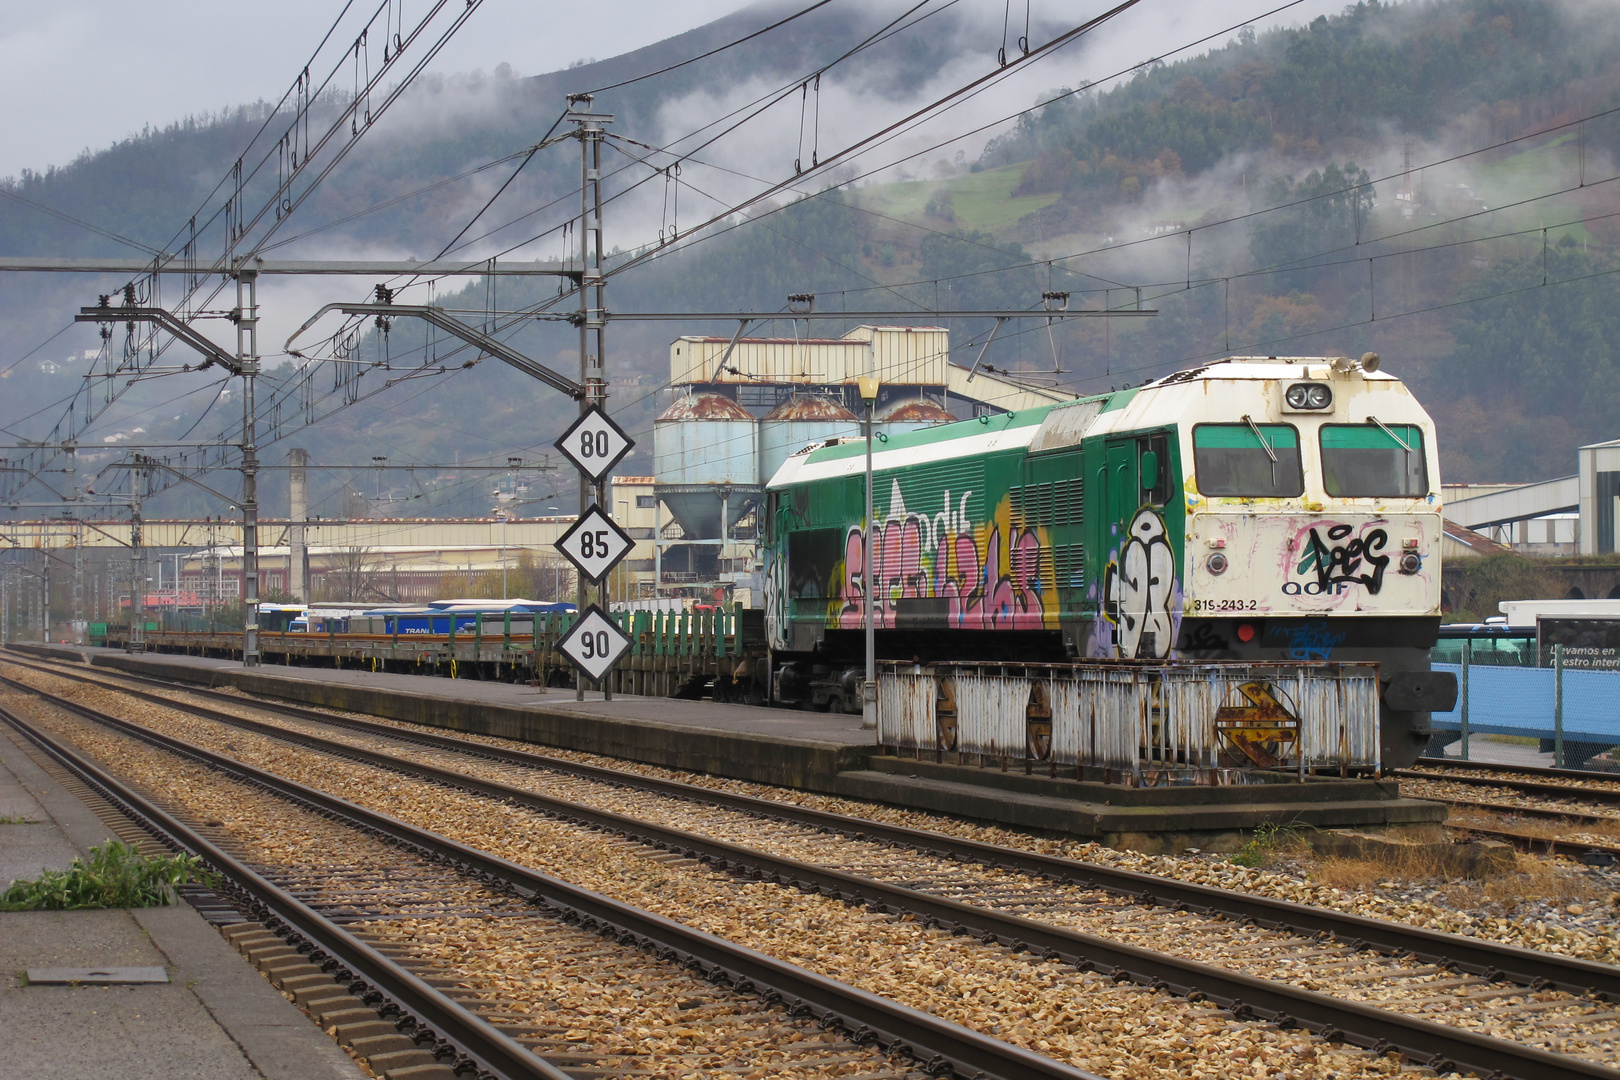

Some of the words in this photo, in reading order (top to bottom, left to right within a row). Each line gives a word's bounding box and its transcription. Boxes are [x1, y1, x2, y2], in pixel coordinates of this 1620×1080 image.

[580, 430, 609, 458] 80
[580, 531, 609, 558] 85
[1194, 599, 1257, 611] 315-243-2
[581, 630, 609, 659] 90
[1550, 645, 1600, 655] Levamos
[1601, 647, 1616, 655] en
[1549, 657, 1590, 667] nestro
